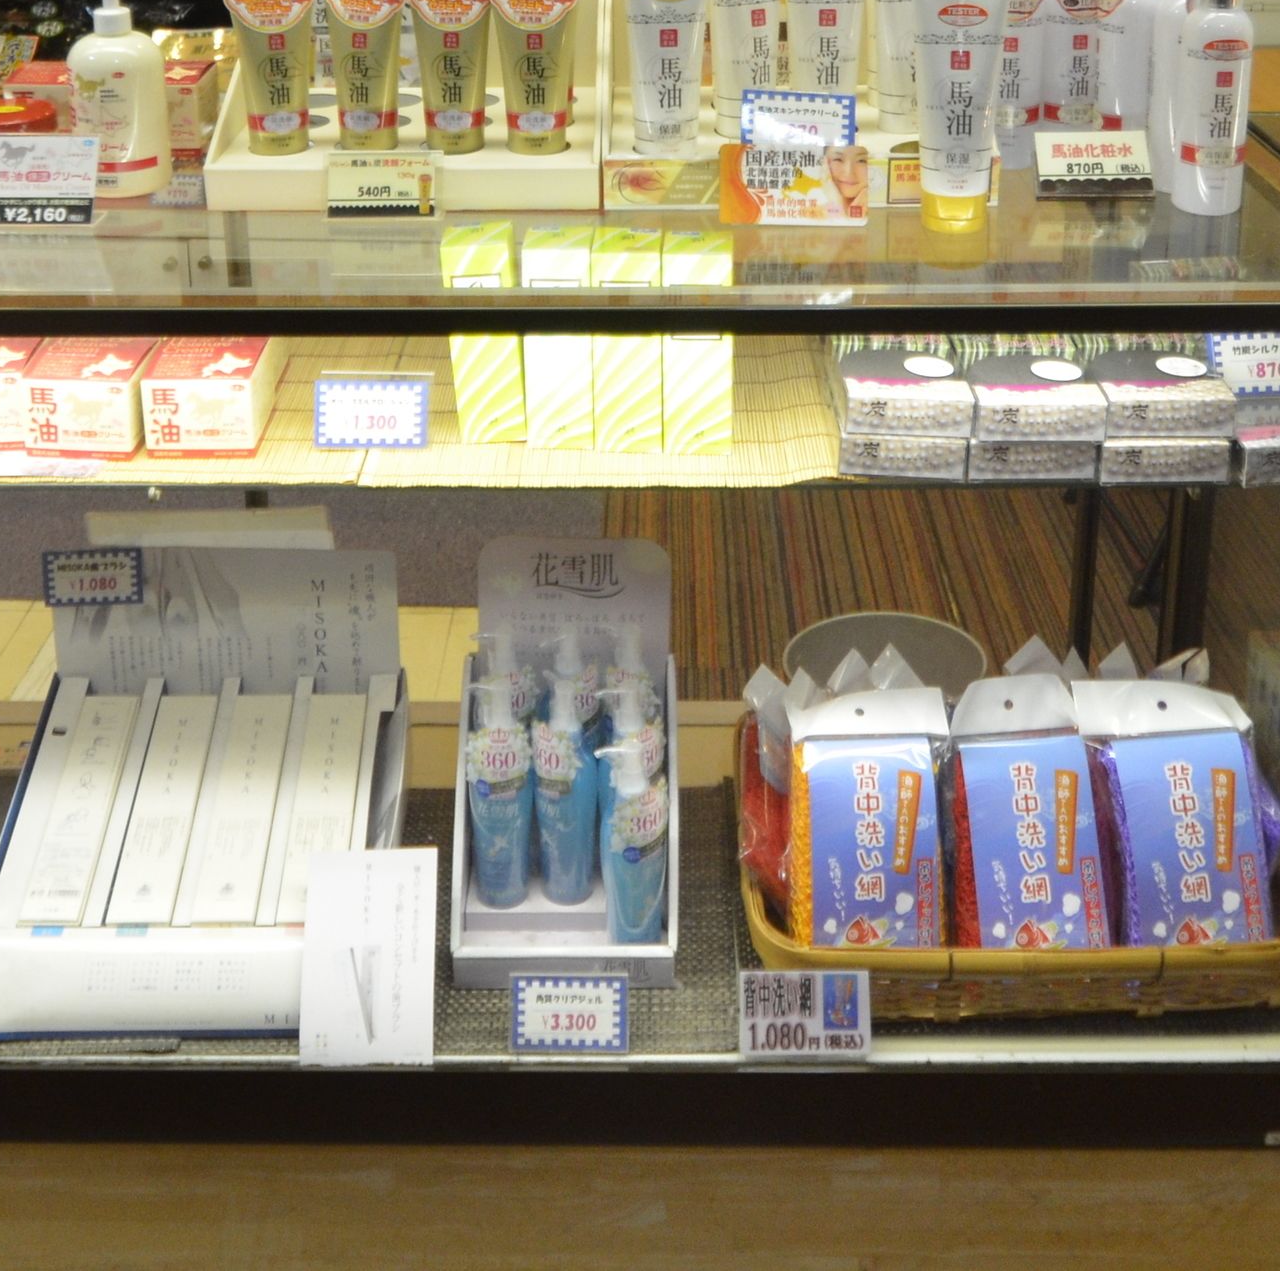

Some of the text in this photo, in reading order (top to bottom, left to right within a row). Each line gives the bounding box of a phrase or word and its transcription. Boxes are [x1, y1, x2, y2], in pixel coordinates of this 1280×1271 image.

[268, 55, 291, 106] 馬油
[350, 55, 370, 105] 馬油
[440, 55, 463, 106] 馬油
[524, 55, 546, 106] 馬油
[658, 58, 682, 110] 馬油
[751, 36, 771, 86] 馬油
[816, 36, 839, 86] 馬油
[999, 57, 1021, 101] 馬油
[1069, 54, 1090, 98] 馬油
[946, 81, 973, 138] 馬油
[1209, 94, 1233, 139] 馬油
[1050, 143, 1133, 159] 馬油化粧水
[1065, 162, 1105, 175] 870円
[4, 208, 67, 223] ¥2,160
[358, 186, 391, 197] 540円
[28, 387, 58, 447] 馬油
[149, 388, 182, 447] 馬油
[530, 551, 620, 587] 花雪肌
[310, 579, 328, 675] MISOKA
[852, 762, 887, 904] 背中洗い網
[1010, 763, 1052, 904] 背中洗い網
[1164, 763, 1208, 904] 背中洗い網
[535, 995, 603, 1006] 角質クリアジェル
[743, 977, 816, 1019] 背中洗い網
[808, 1038, 821, 1051] 円
